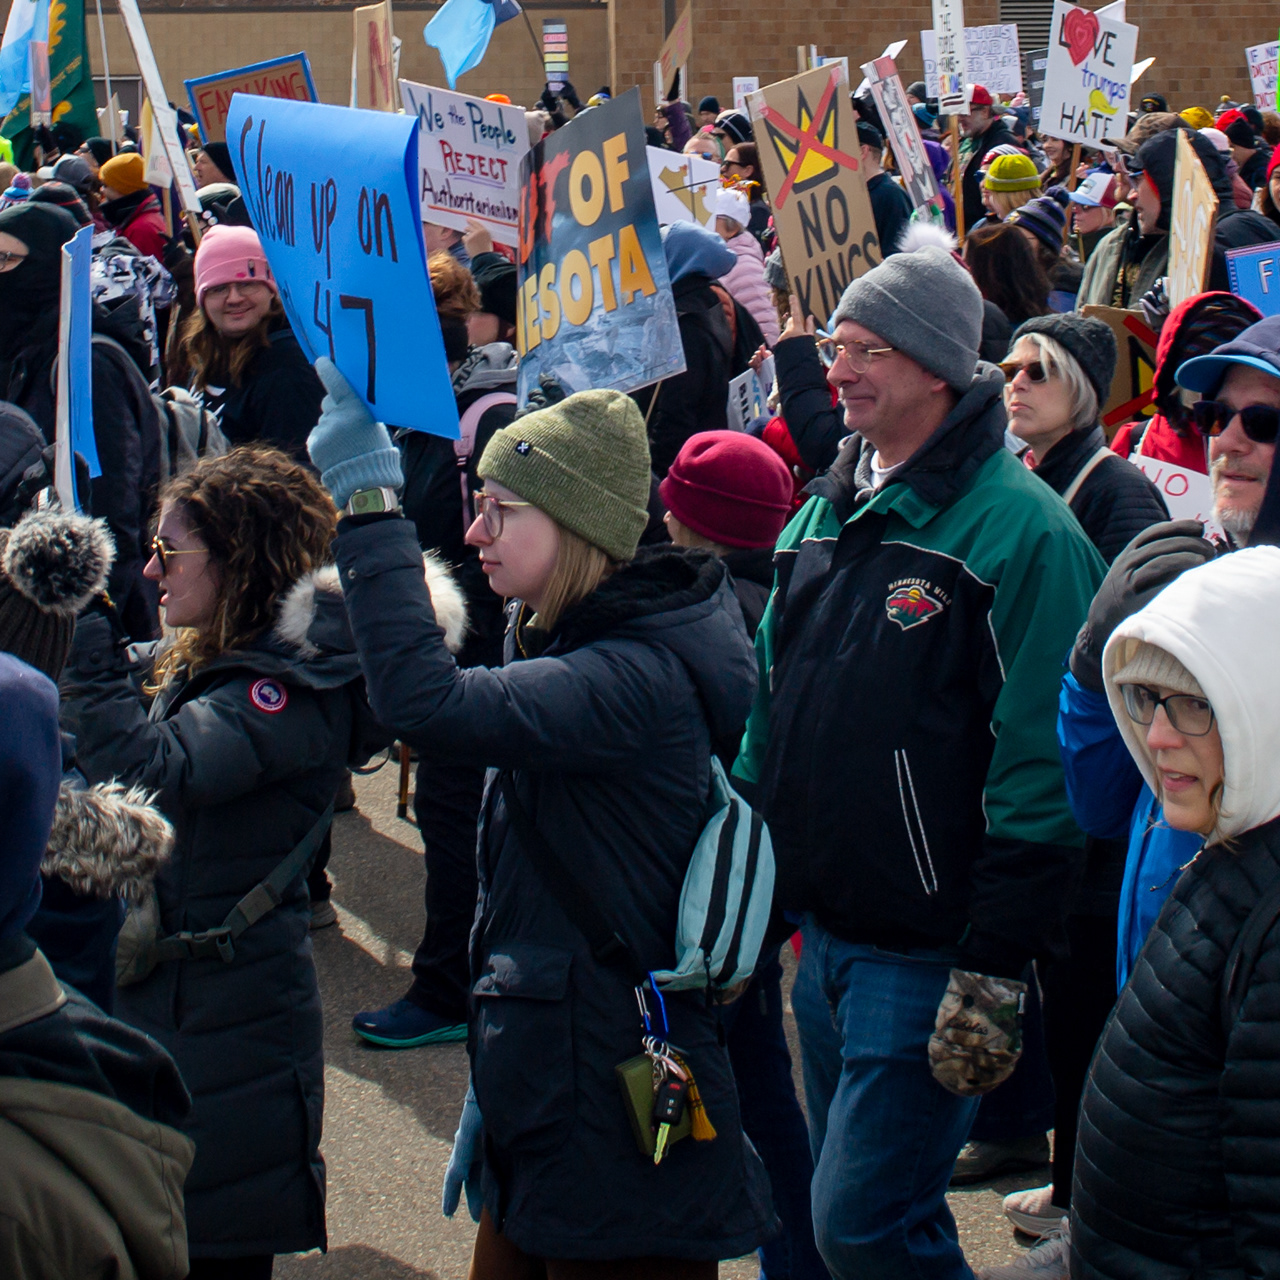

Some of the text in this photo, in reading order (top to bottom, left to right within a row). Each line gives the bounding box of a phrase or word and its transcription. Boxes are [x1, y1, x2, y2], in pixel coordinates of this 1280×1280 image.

[1058, 13, 1117, 67] LVE
[1081, 61, 1128, 105] trumps
[407, 87, 516, 150] We the People
[439, 139, 508, 183] REJECT
[568, 131, 631, 227] OF
[310, 176, 337, 281] up
[357, 185, 399, 264] on
[797, 184, 850, 259] NO
[312, 280, 377, 406] 47
